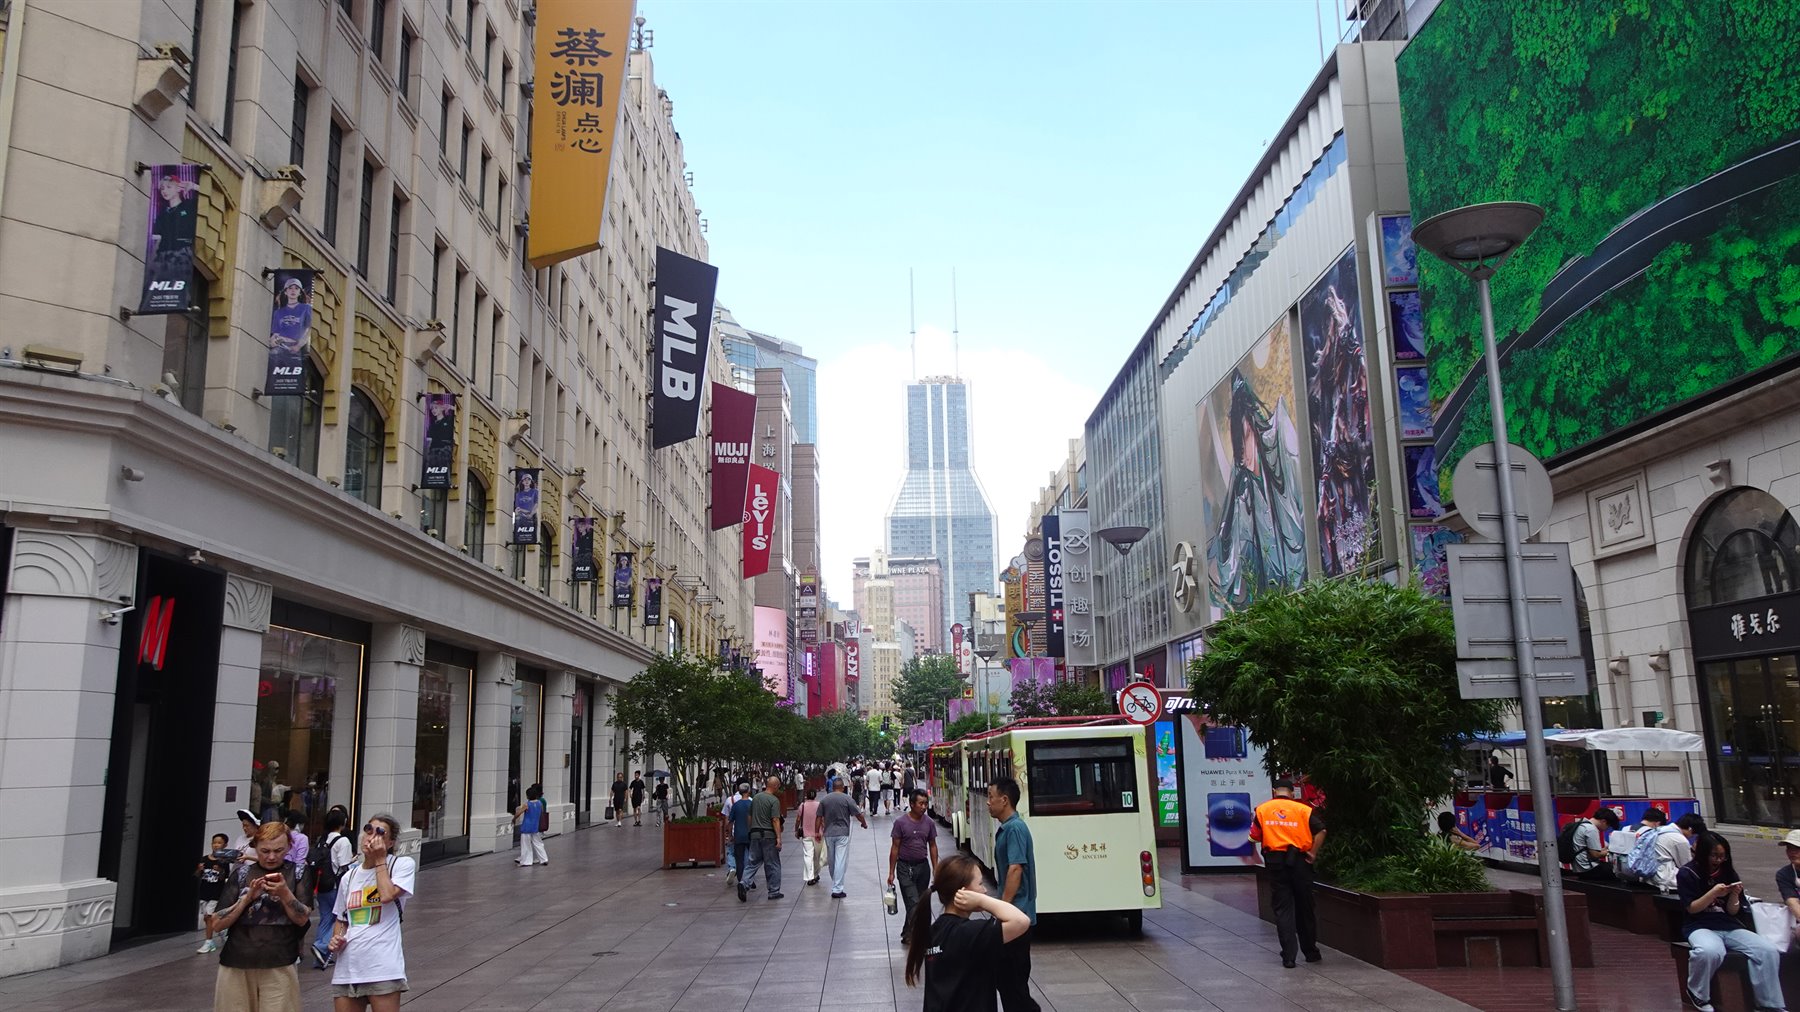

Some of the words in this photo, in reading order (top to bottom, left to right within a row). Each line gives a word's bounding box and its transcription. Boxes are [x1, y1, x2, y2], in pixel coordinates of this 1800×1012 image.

[550, 27, 612, 108] 蔡澜
[570, 112, 603, 153] 点心
[149, 281, 185, 290] MLB
[662, 295, 697, 401] MLB
[273, 366, 302, 375] MLB
[715, 442, 748, 456] MUJI
[1069, 564, 1090, 647] 创趣场
[1731, 608, 1780, 641] 雅戈尔
[847, 646, 858, 677] KFC
[1122, 793, 1132, 806] 10
